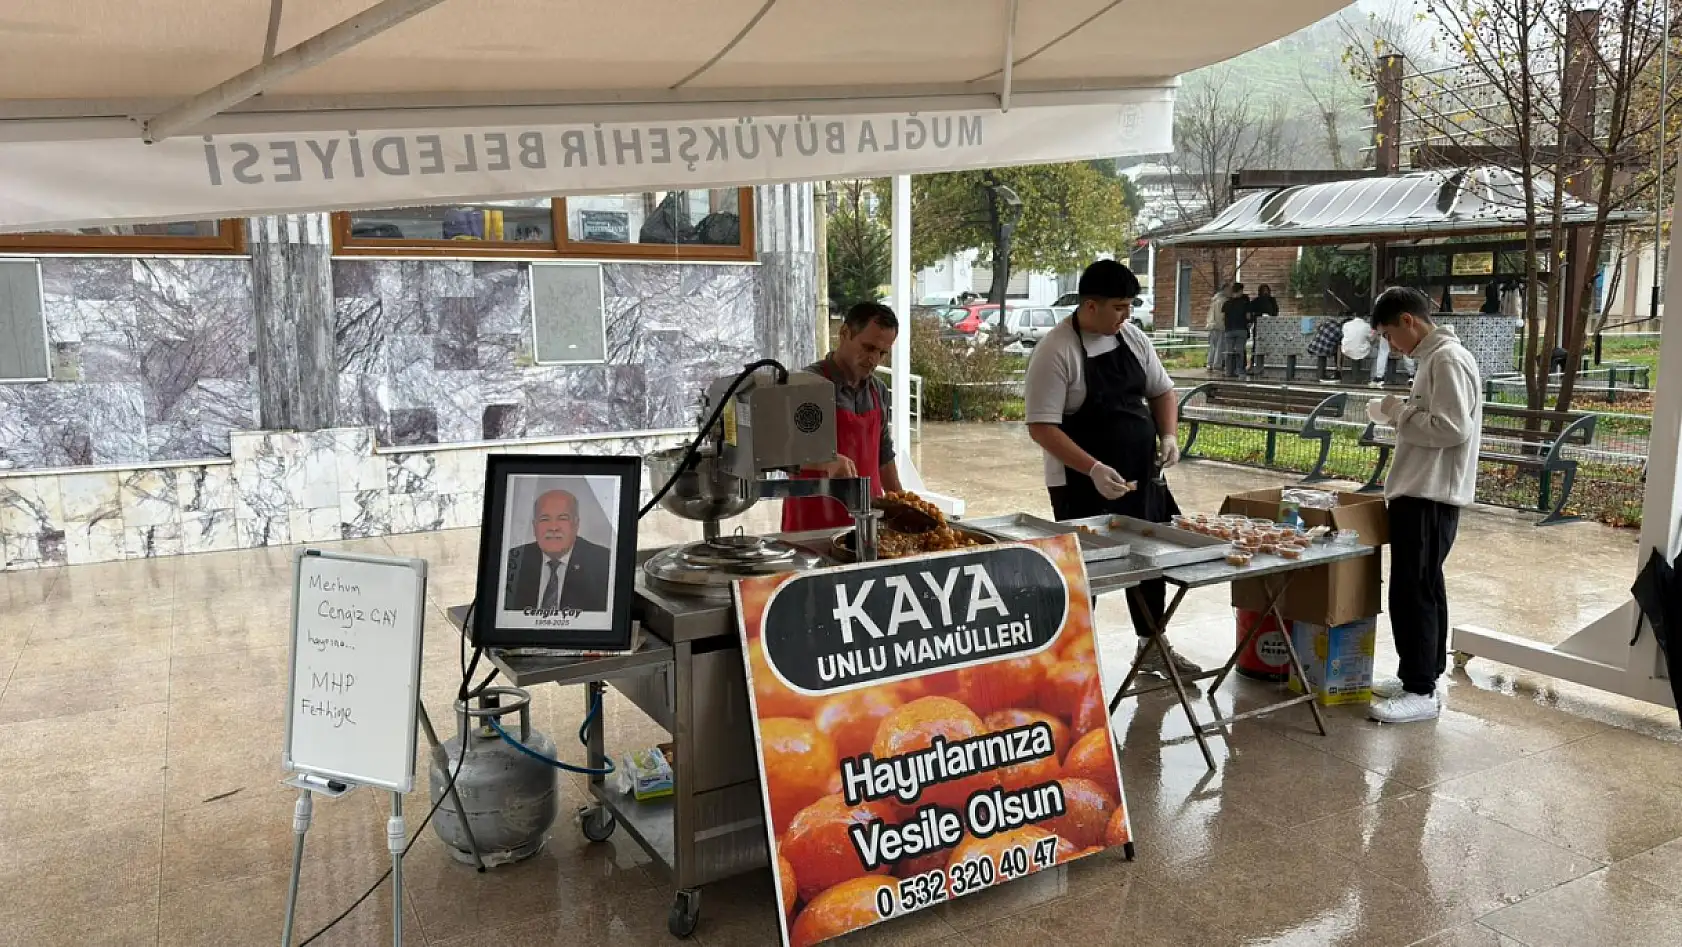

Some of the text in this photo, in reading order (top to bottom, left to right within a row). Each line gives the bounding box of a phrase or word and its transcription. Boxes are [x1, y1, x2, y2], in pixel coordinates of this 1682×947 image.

[309, 574, 361, 596] Merhum
[318, 600, 366, 629] Cengiz
[833, 563, 1009, 645] KAYA
[817, 613, 1033, 682] UNLU MAMÜLLERİ
[301, 698, 356, 728] Fethiye
[312, 672, 354, 694] MHP
[844, 723, 1052, 801] Hayırlarınıza
[852, 784, 1064, 870] Vesile Olsun
[877, 836, 1059, 917] 0 532 320 40 47
